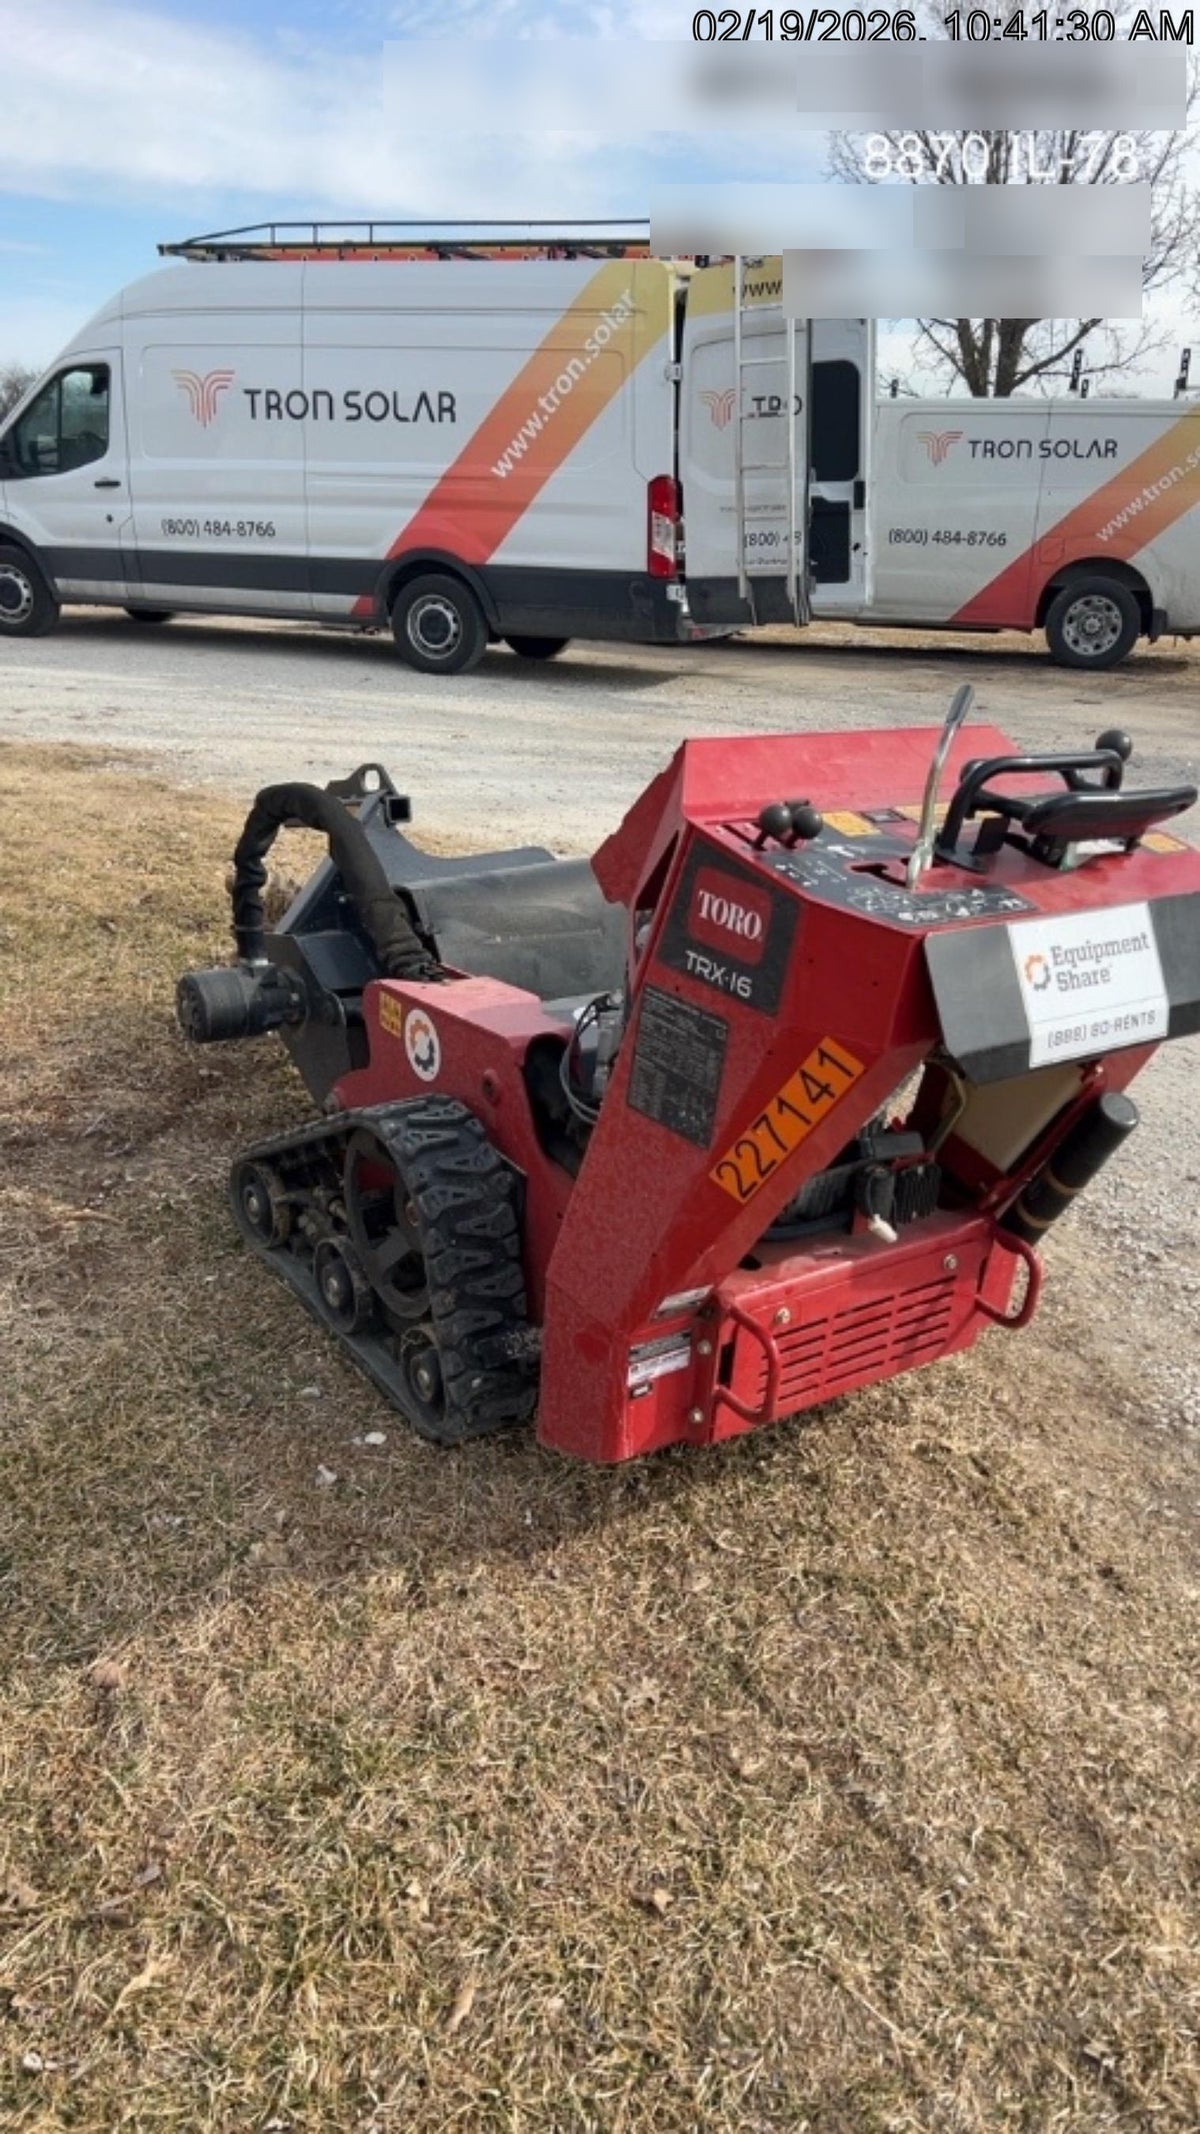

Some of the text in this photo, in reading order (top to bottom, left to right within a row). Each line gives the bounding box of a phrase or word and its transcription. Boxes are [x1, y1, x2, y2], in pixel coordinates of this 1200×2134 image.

[490, 288, 636, 478] www.tron.solar
[243, 388, 456, 423] TRON SOLAR
[968, 438, 1118, 459] TRON SOLAR
[161, 518, 276, 538] (800) 484-8766
[888, 528, 1008, 547] (800) 484-8766
[699, 889, 762, 940] TORO
[1050, 931, 1150, 969] Equipment
[685, 950, 753, 998] TRX-16
[1055, 966, 1112, 992] Share
[715, 1047, 855, 1199] 227141
